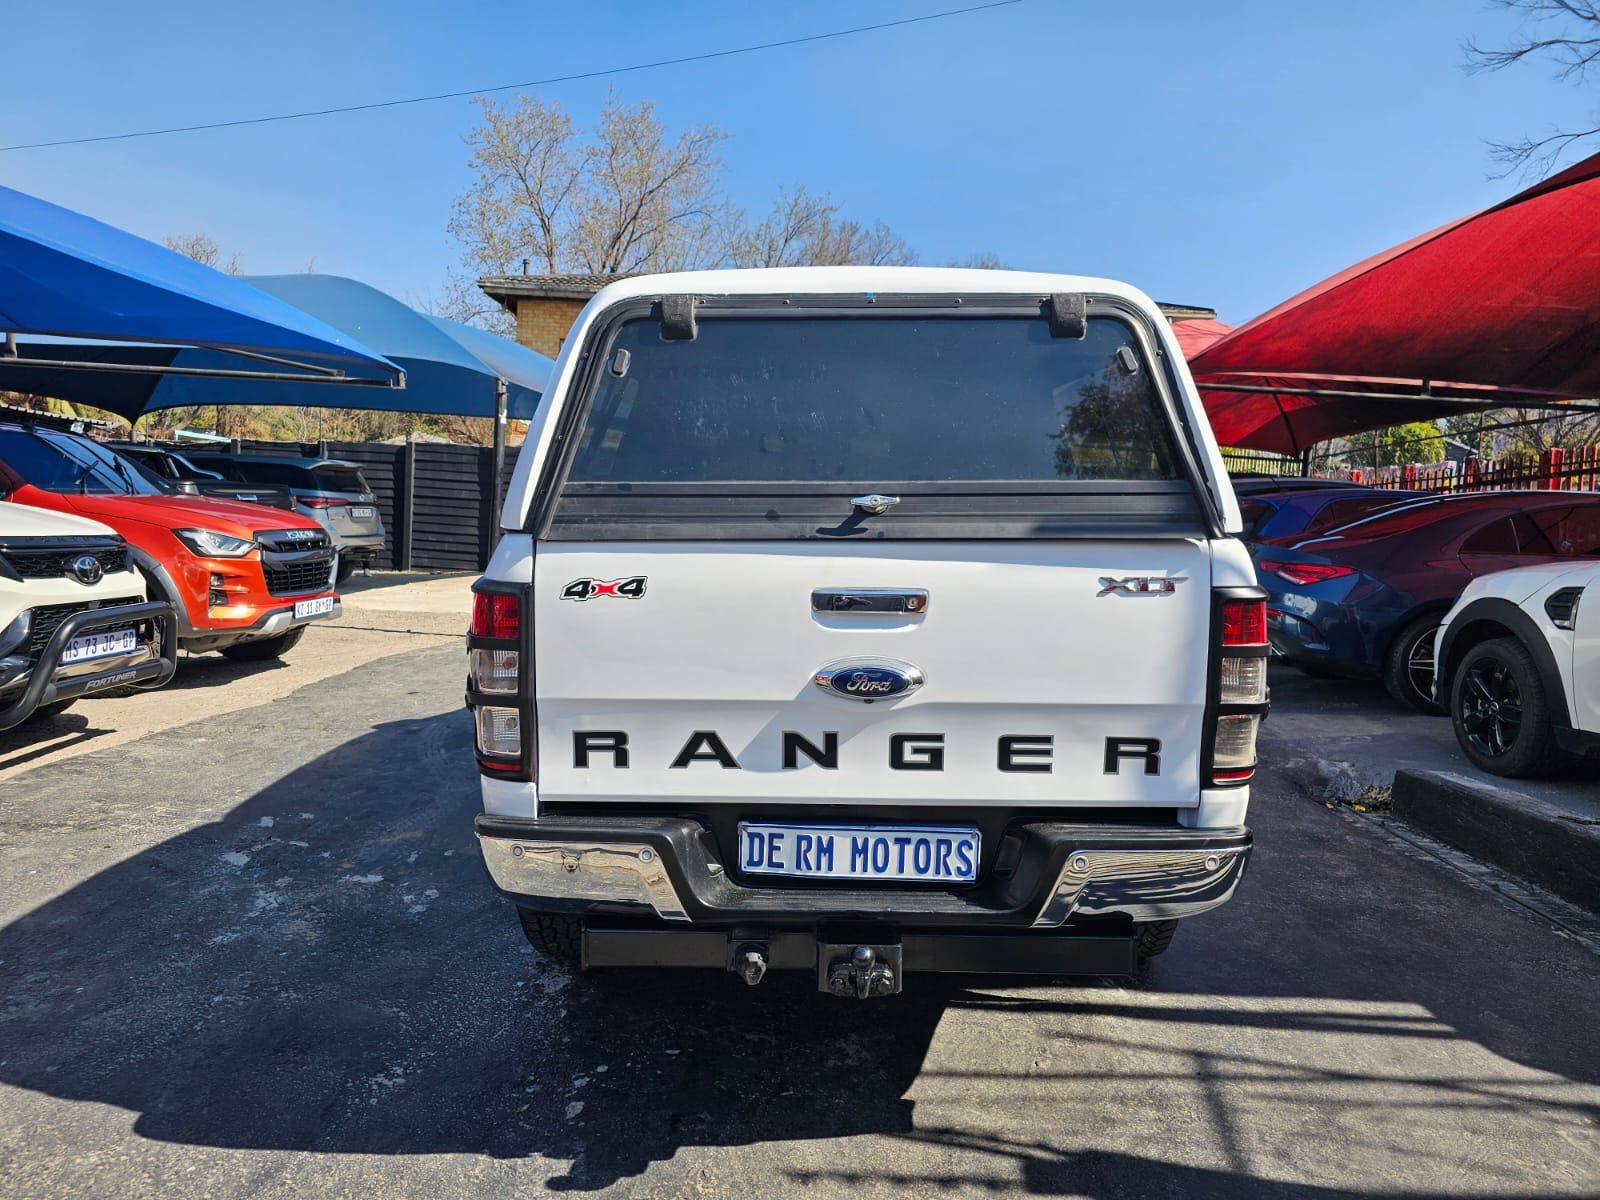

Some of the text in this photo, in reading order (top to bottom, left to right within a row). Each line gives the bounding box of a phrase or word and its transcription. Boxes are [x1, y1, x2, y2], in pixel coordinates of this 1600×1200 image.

[1096, 577, 1189, 598] XLT
[65, 631, 135, 659] MS 73 JC GP
[84, 671, 137, 692] FORTUNER
[846, 671, 893, 692] Ford
[572, 730, 1162, 776] RANGER
[746, 831, 974, 877] DE RM MOTORS
